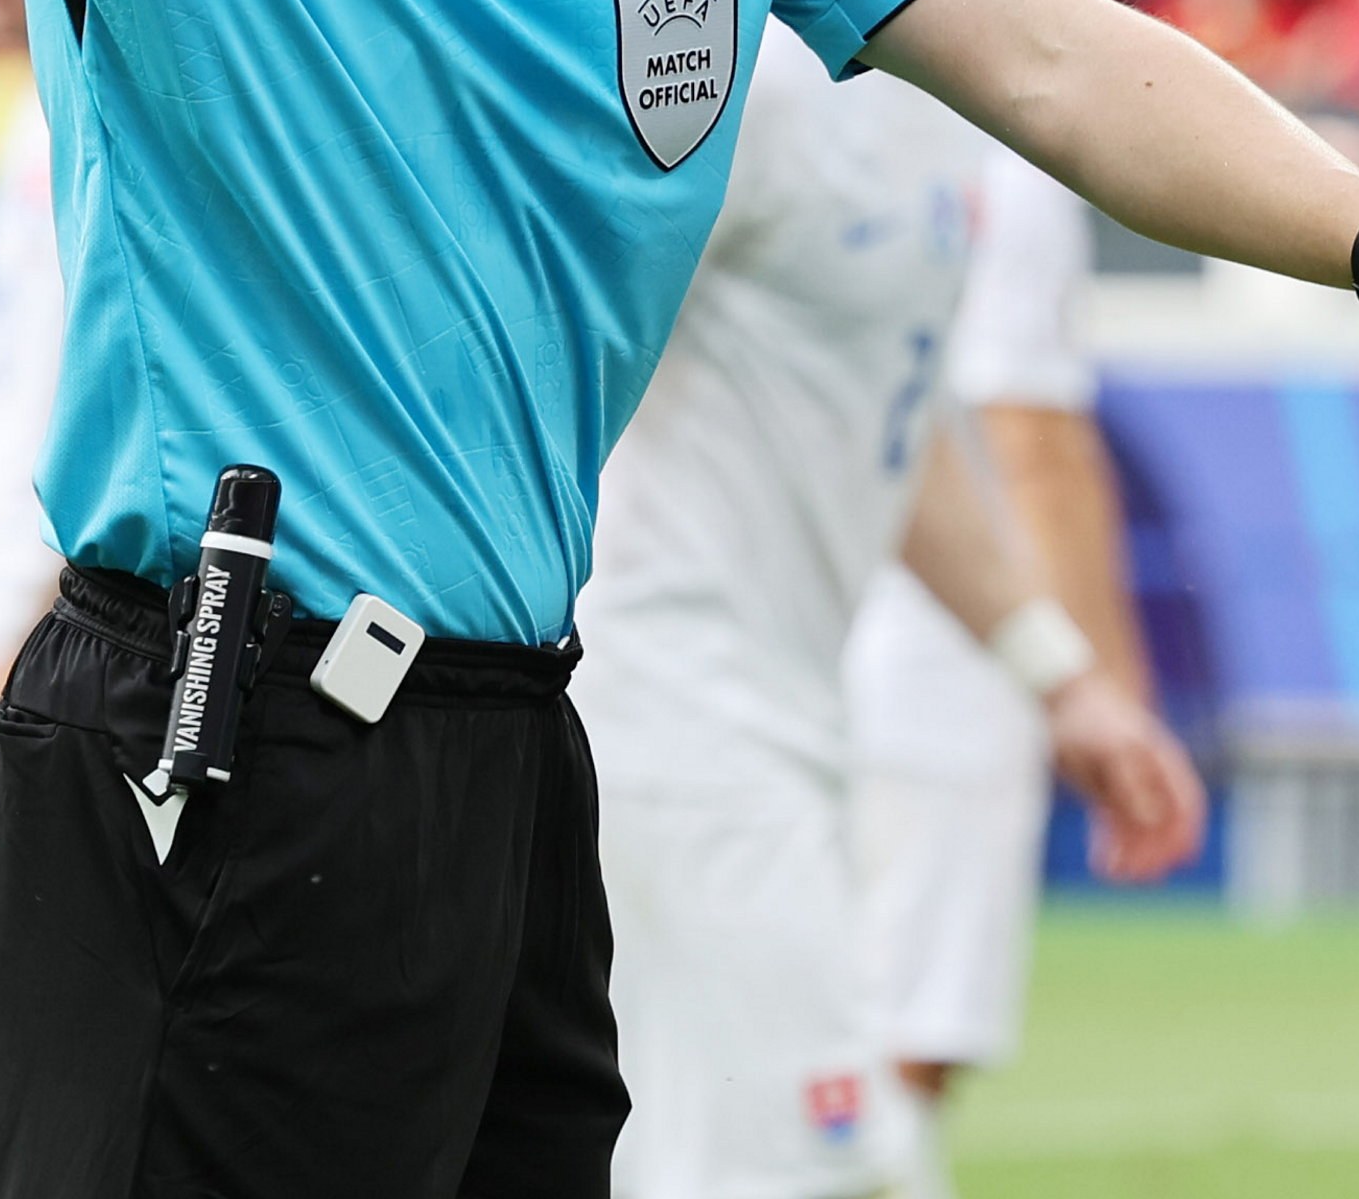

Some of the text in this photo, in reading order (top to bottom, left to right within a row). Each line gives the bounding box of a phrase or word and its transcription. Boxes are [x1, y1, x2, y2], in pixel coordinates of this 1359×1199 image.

[646, 48, 712, 79] MATCH
[639, 78, 719, 110] OFFICIAL
[173, 564, 233, 752] VANISHING SPRAY
